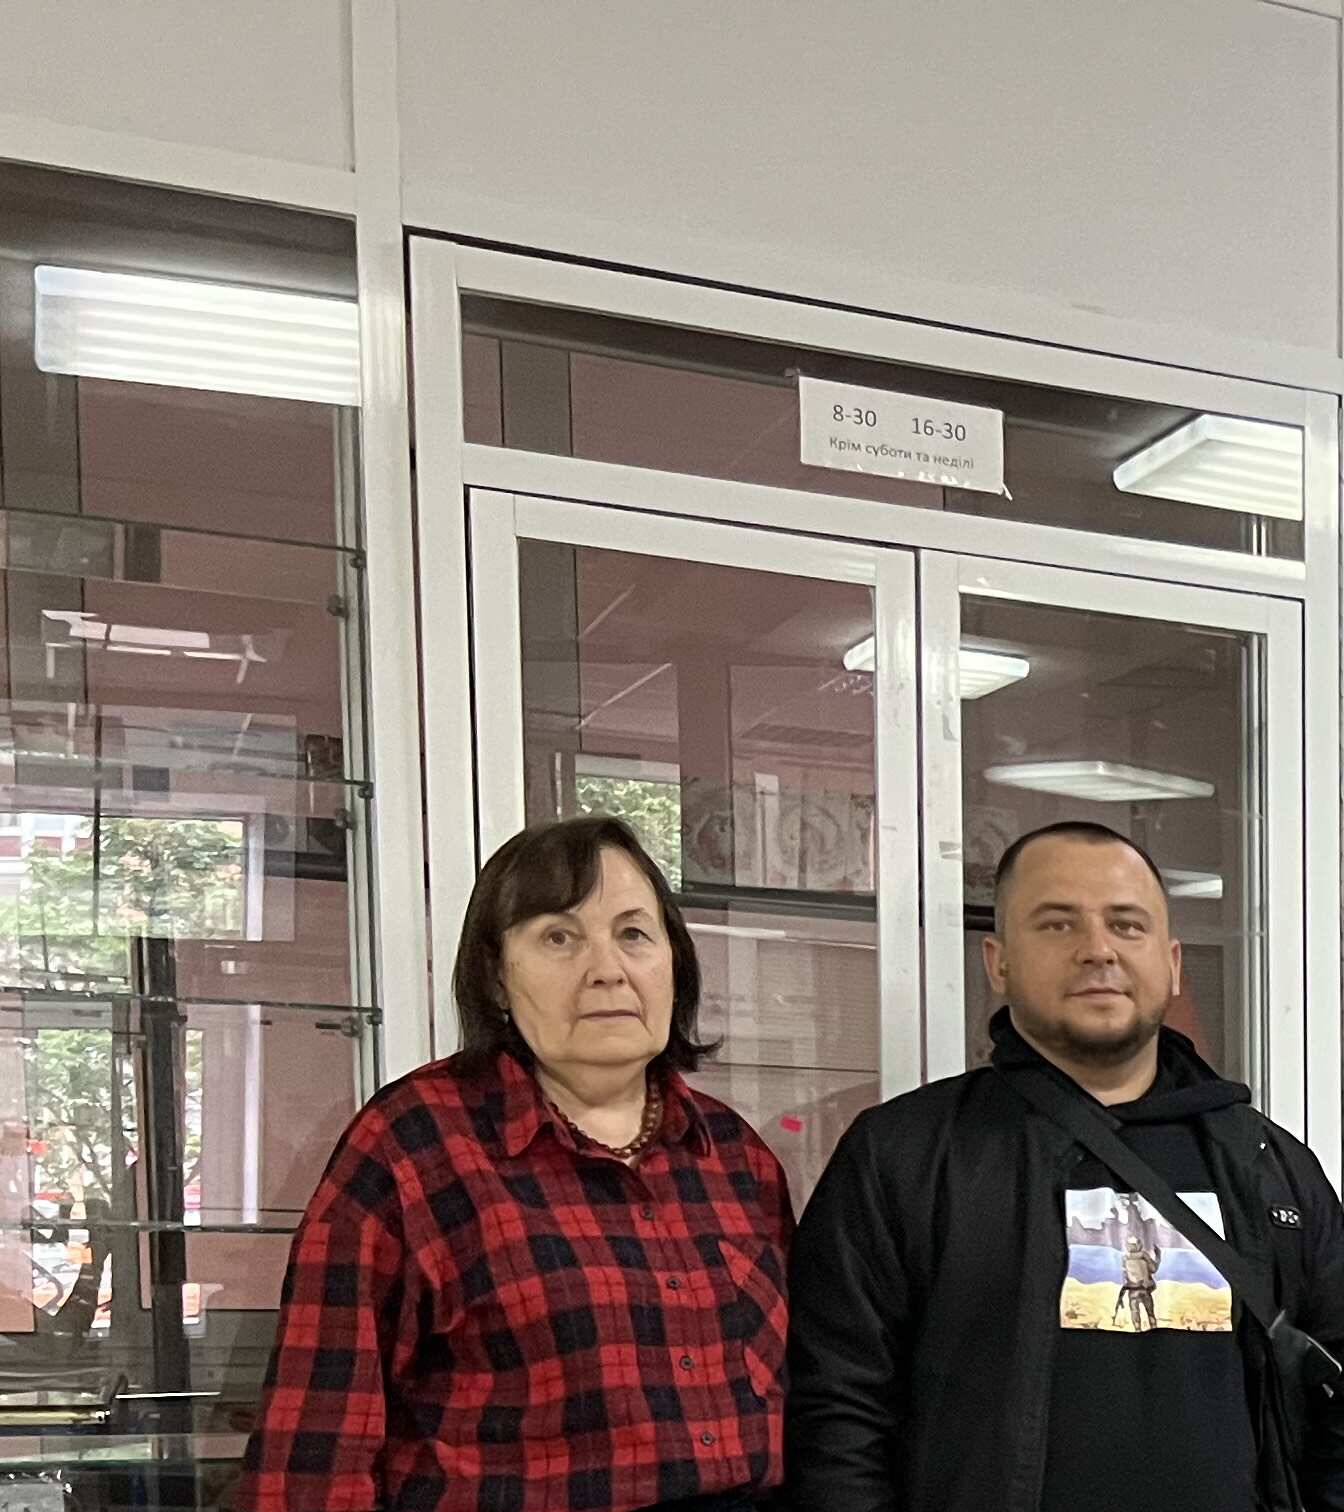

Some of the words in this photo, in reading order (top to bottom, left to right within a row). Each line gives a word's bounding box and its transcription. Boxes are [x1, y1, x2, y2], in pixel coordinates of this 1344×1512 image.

[832, 404, 877, 427] 8-30
[911, 417, 967, 442] 16-30
[829, 437, 861, 453] Крім
[865, 444, 912, 461] суботи
[916, 452, 930, 463] та
[933, 456, 974, 469] неділі
